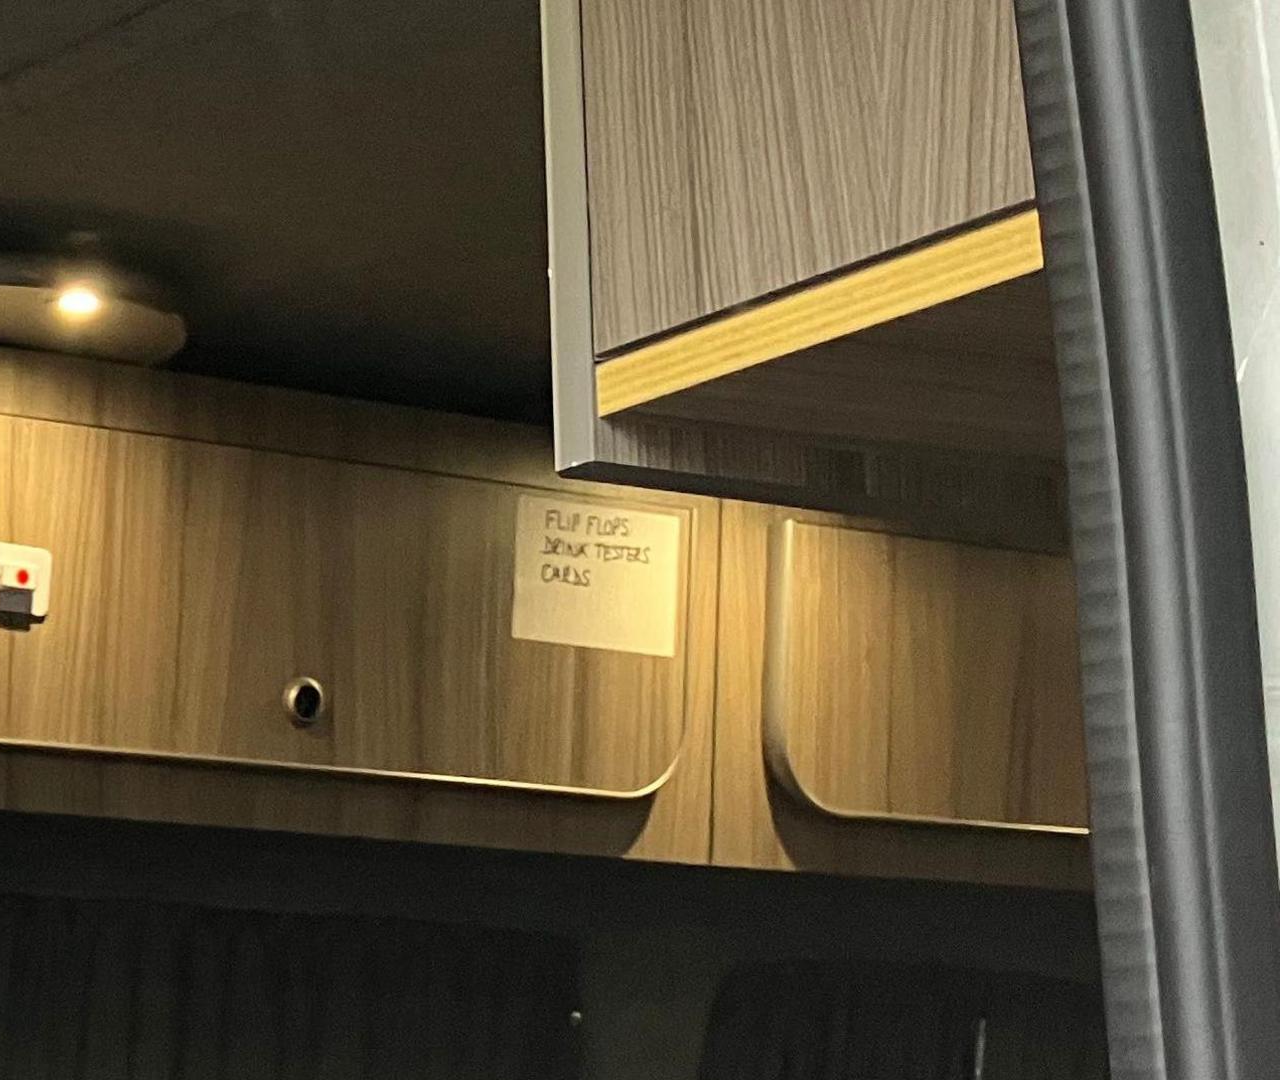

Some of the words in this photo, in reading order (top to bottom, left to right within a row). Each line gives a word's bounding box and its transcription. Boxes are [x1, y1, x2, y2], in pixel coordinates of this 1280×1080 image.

[545, 509, 580, 532] FLIP
[586, 515, 630, 537] FLOPS
[541, 536, 587, 558] DRINK
[594, 543, 651, 564] TESTERS
[541, 563, 591, 587] CARDS
